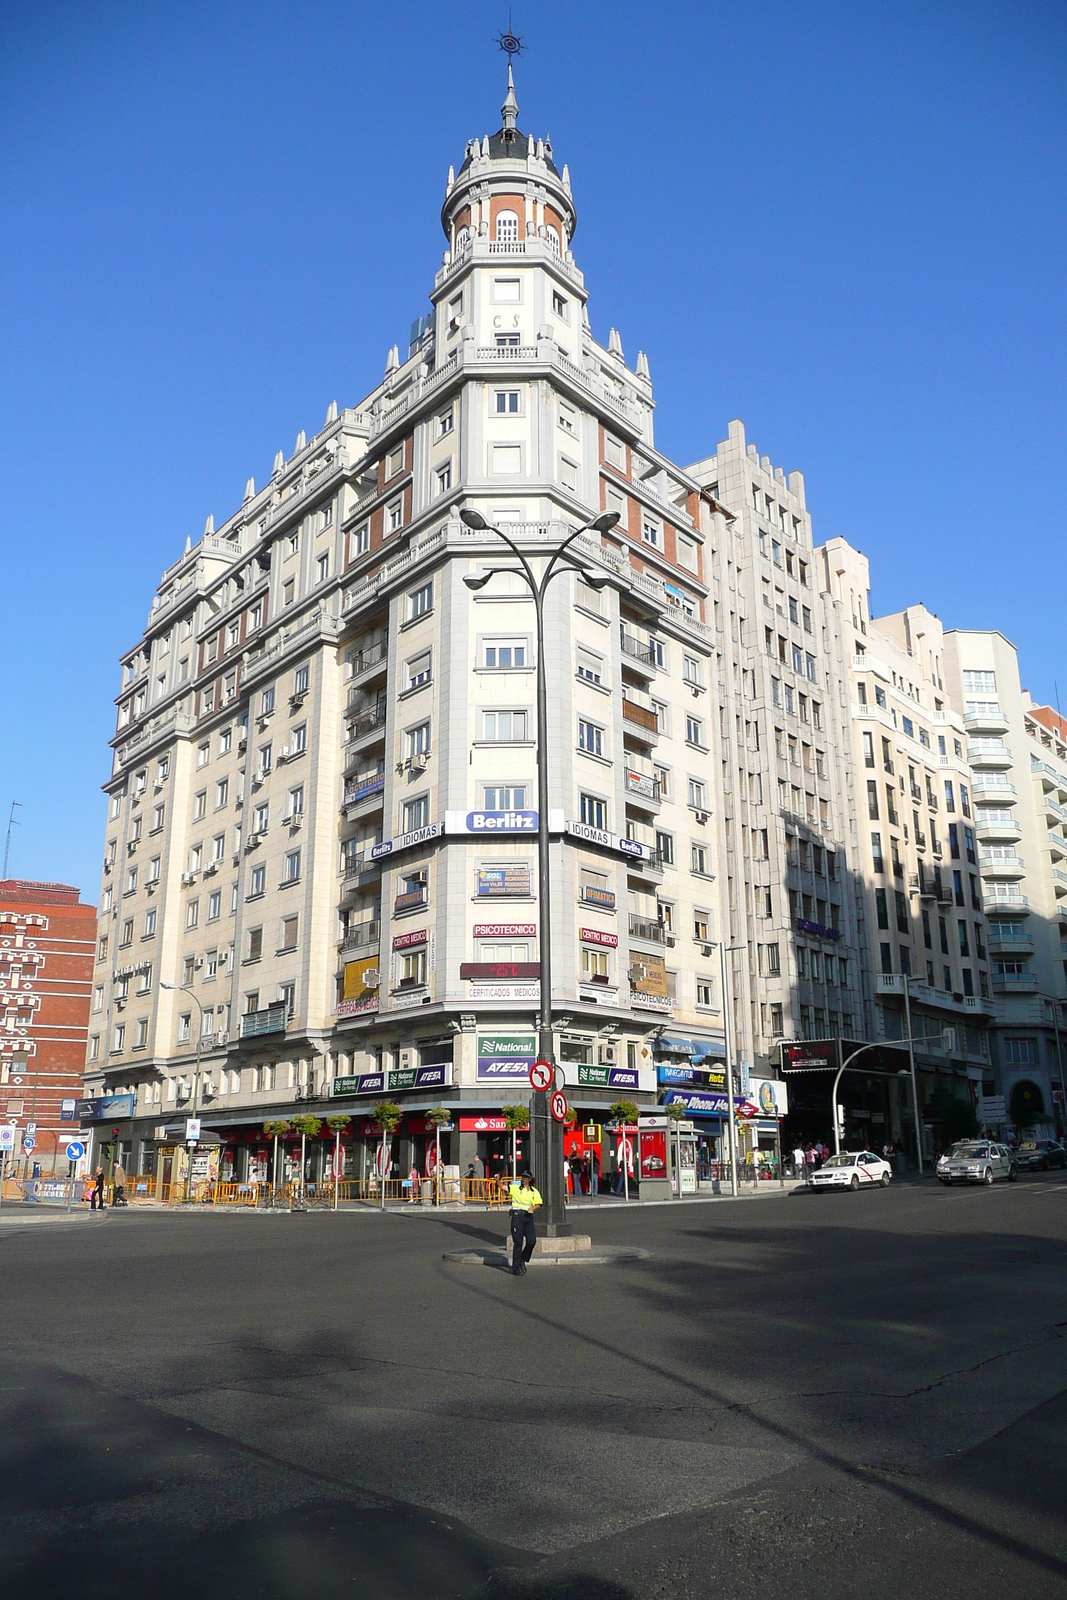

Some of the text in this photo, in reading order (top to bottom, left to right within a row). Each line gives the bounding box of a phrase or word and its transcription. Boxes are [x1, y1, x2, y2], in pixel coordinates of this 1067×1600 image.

[346, 772, 384, 795] LOCUTORIO
[472, 814, 534, 828] Berlitz
[372, 826, 436, 856] Berlitz IDIOMAS
[572, 823, 641, 854] IDIOMAS Berlitz
[586, 888, 614, 902] OFIMATICA
[475, 926, 535, 934] PSICOTECNICO
[394, 932, 426, 947] CENTRO MEDICO
[582, 930, 618, 946] CENTRO MEDICO
[514, 988, 540, 996] MEDICOS
[630, 990, 672, 1006] PSICOTECNICOS
[486, 1062, 528, 1072] ATESA
[589, 1068, 606, 1077] National
[362, 1078, 381, 1088] ATESA
[420, 1071, 441, 1081] ATESA
[613, 1074, 635, 1083] ATESA
[708, 1074, 724, 1083] Hertz
[672, 1096, 688, 1105] The
[688, 1097, 715, 1110] Phone
[714, 1099, 740, 1111] Hoe
